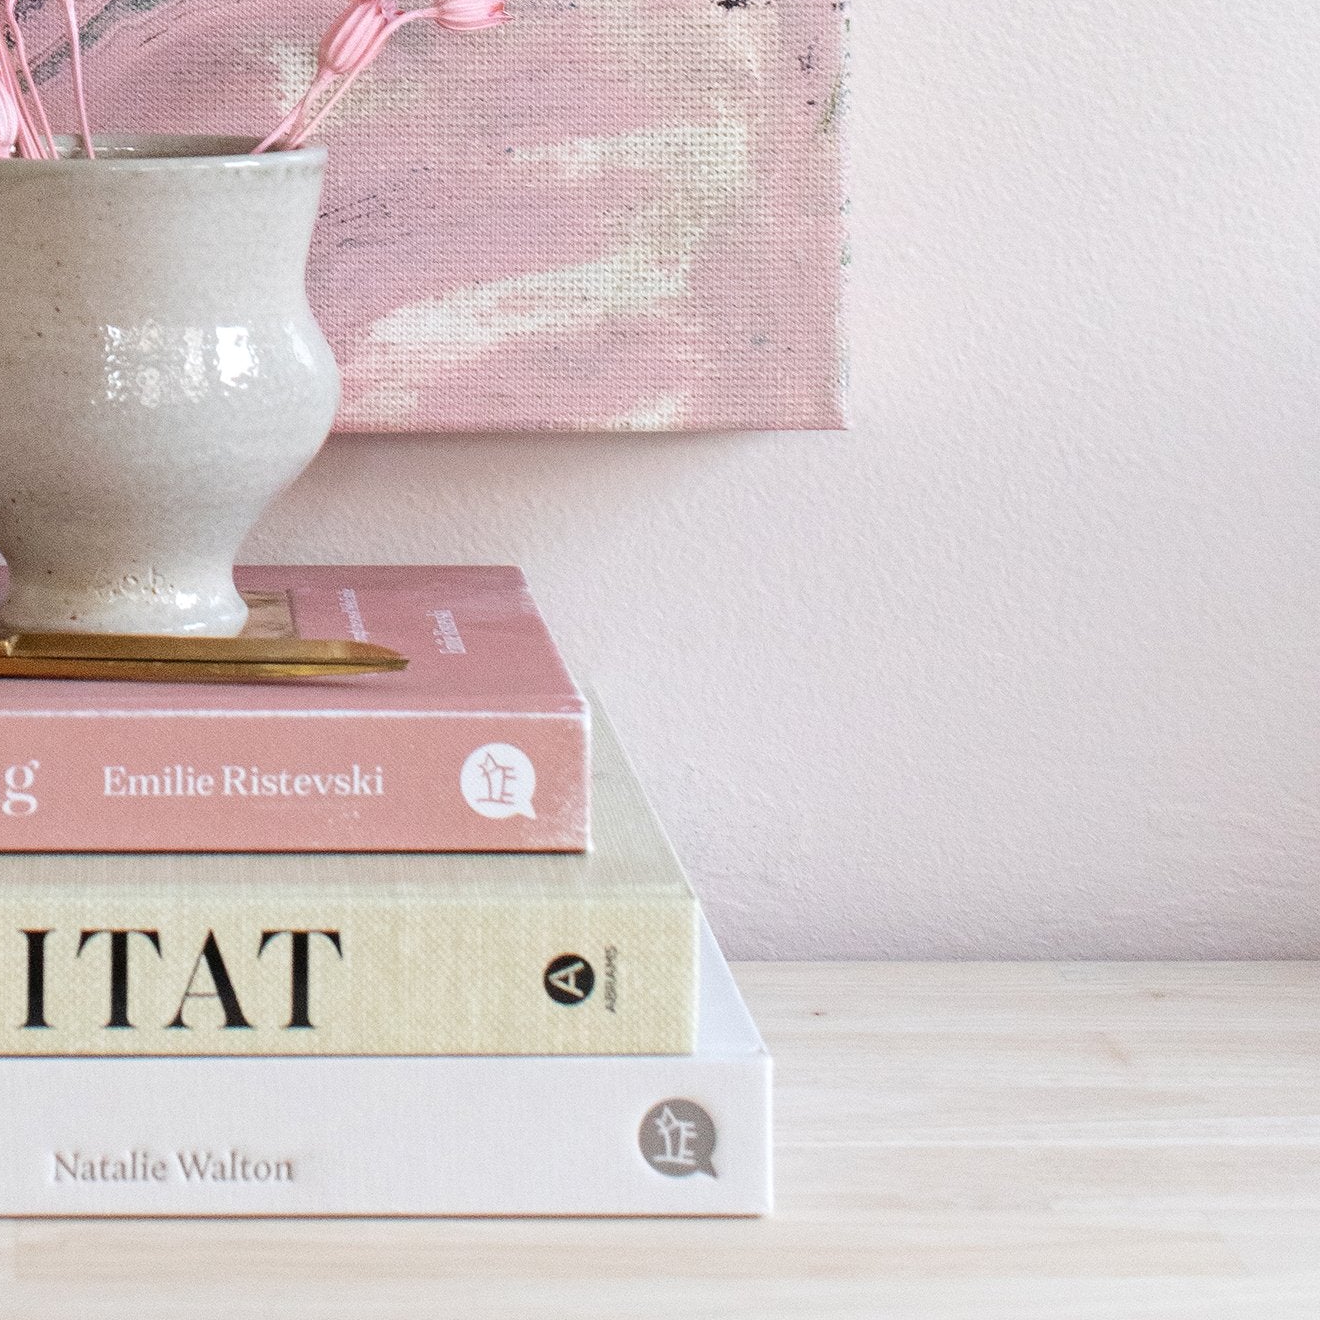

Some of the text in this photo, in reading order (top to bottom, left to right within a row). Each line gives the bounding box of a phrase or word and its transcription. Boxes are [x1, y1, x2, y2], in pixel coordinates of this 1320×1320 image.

[102, 763, 386, 798] Emilie Ristevski
[603, 944, 619, 1014] ABRAMS
[53, 1149, 297, 1184] Natalie Walton
